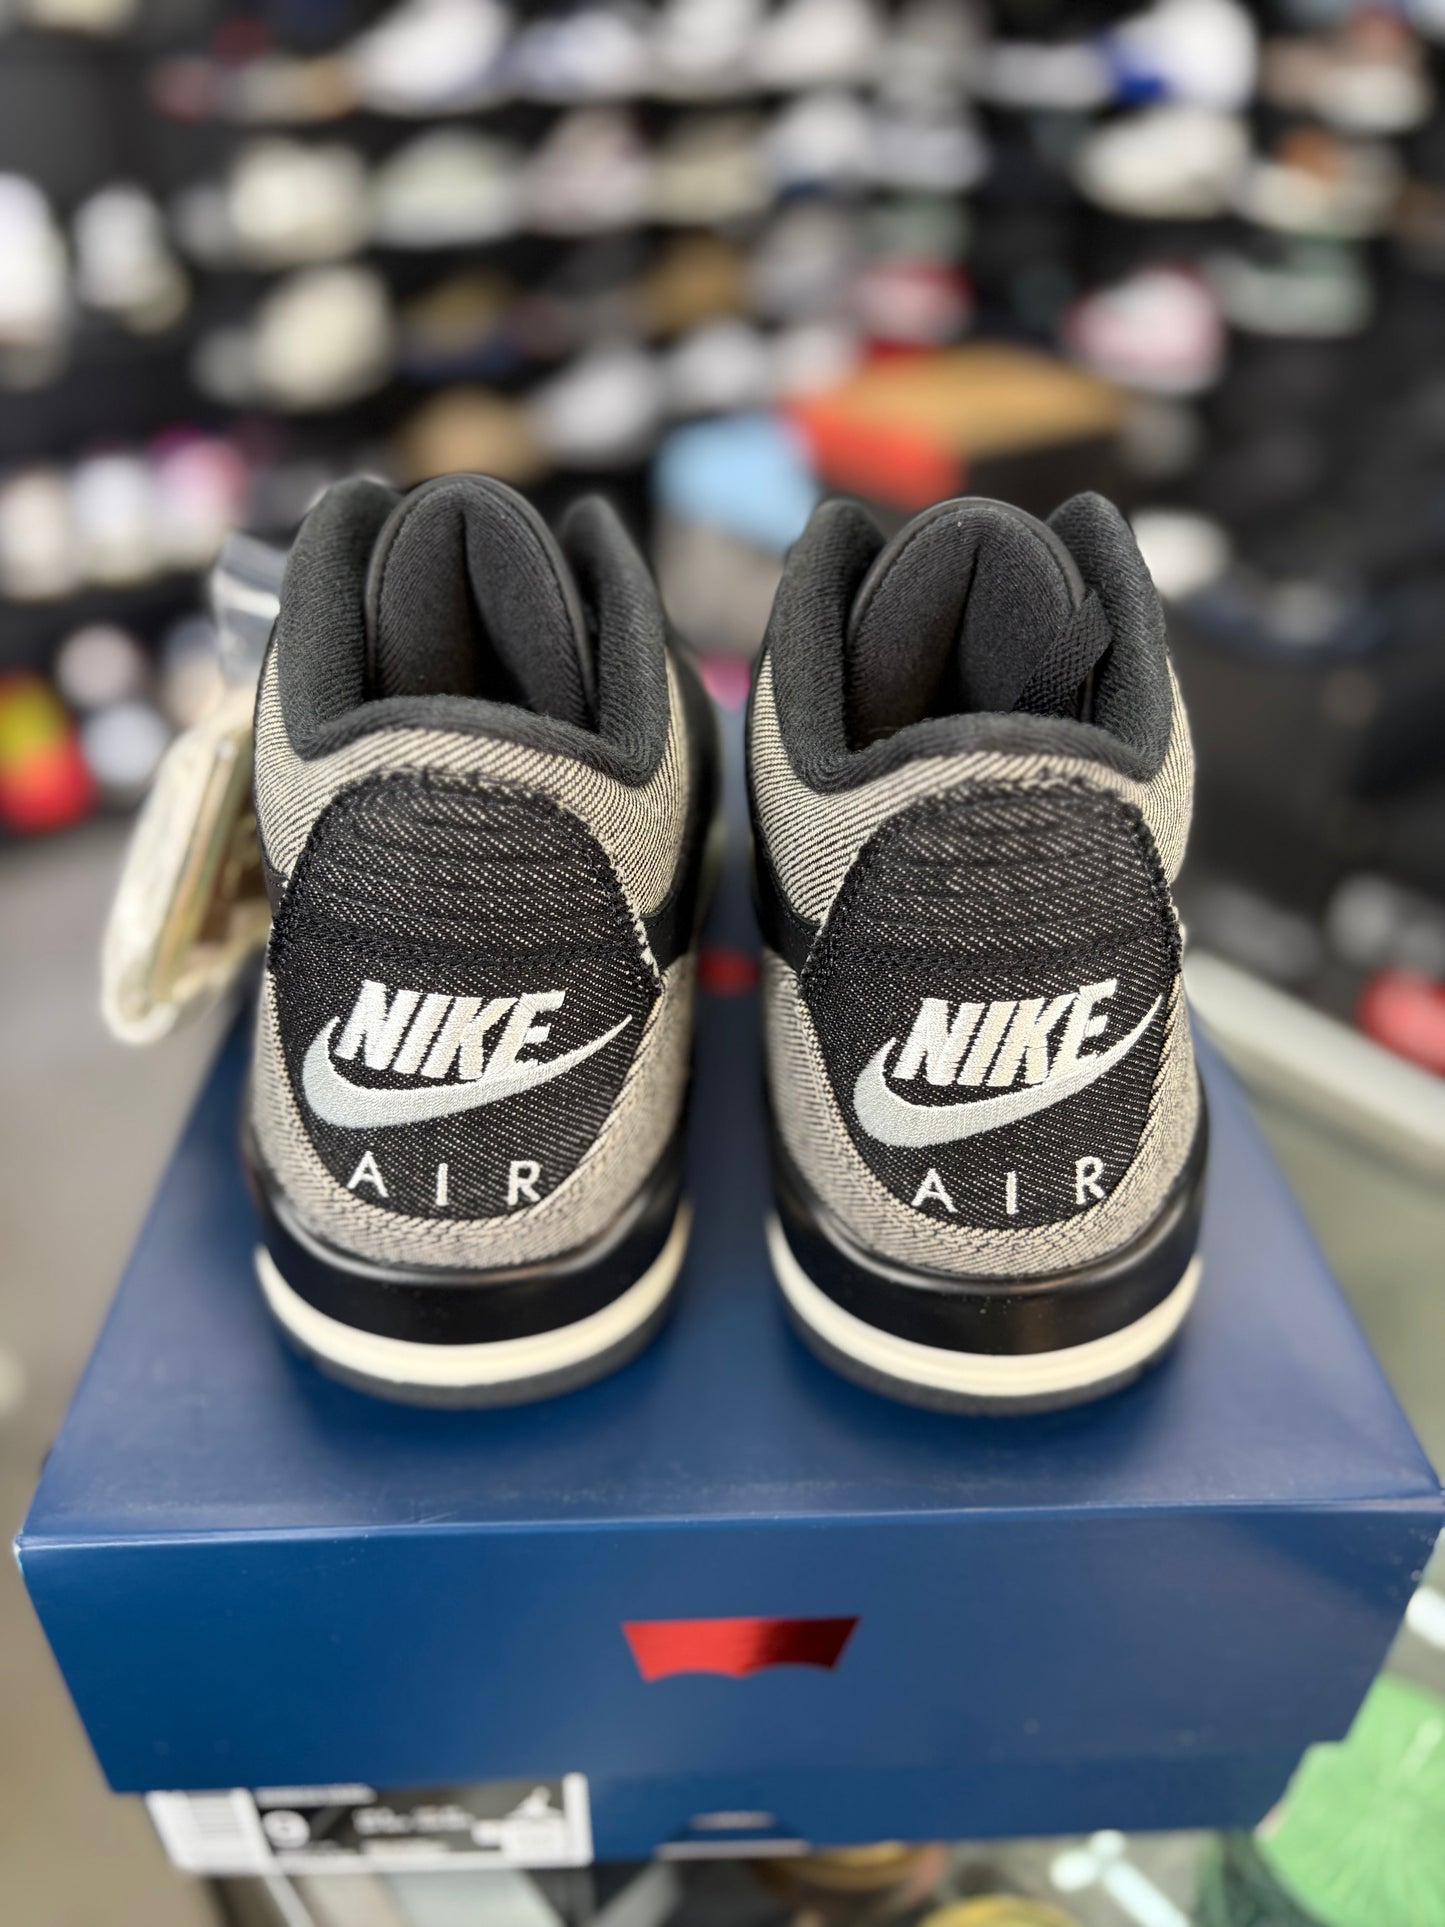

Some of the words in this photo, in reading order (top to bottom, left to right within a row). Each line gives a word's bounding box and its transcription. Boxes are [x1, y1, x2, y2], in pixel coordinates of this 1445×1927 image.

[334, 979, 566, 1080] NIKE
[892, 979, 1118, 1088] NIKE
[347, 1150, 542, 1206] AIR
[911, 1155, 1106, 1215] AIR
